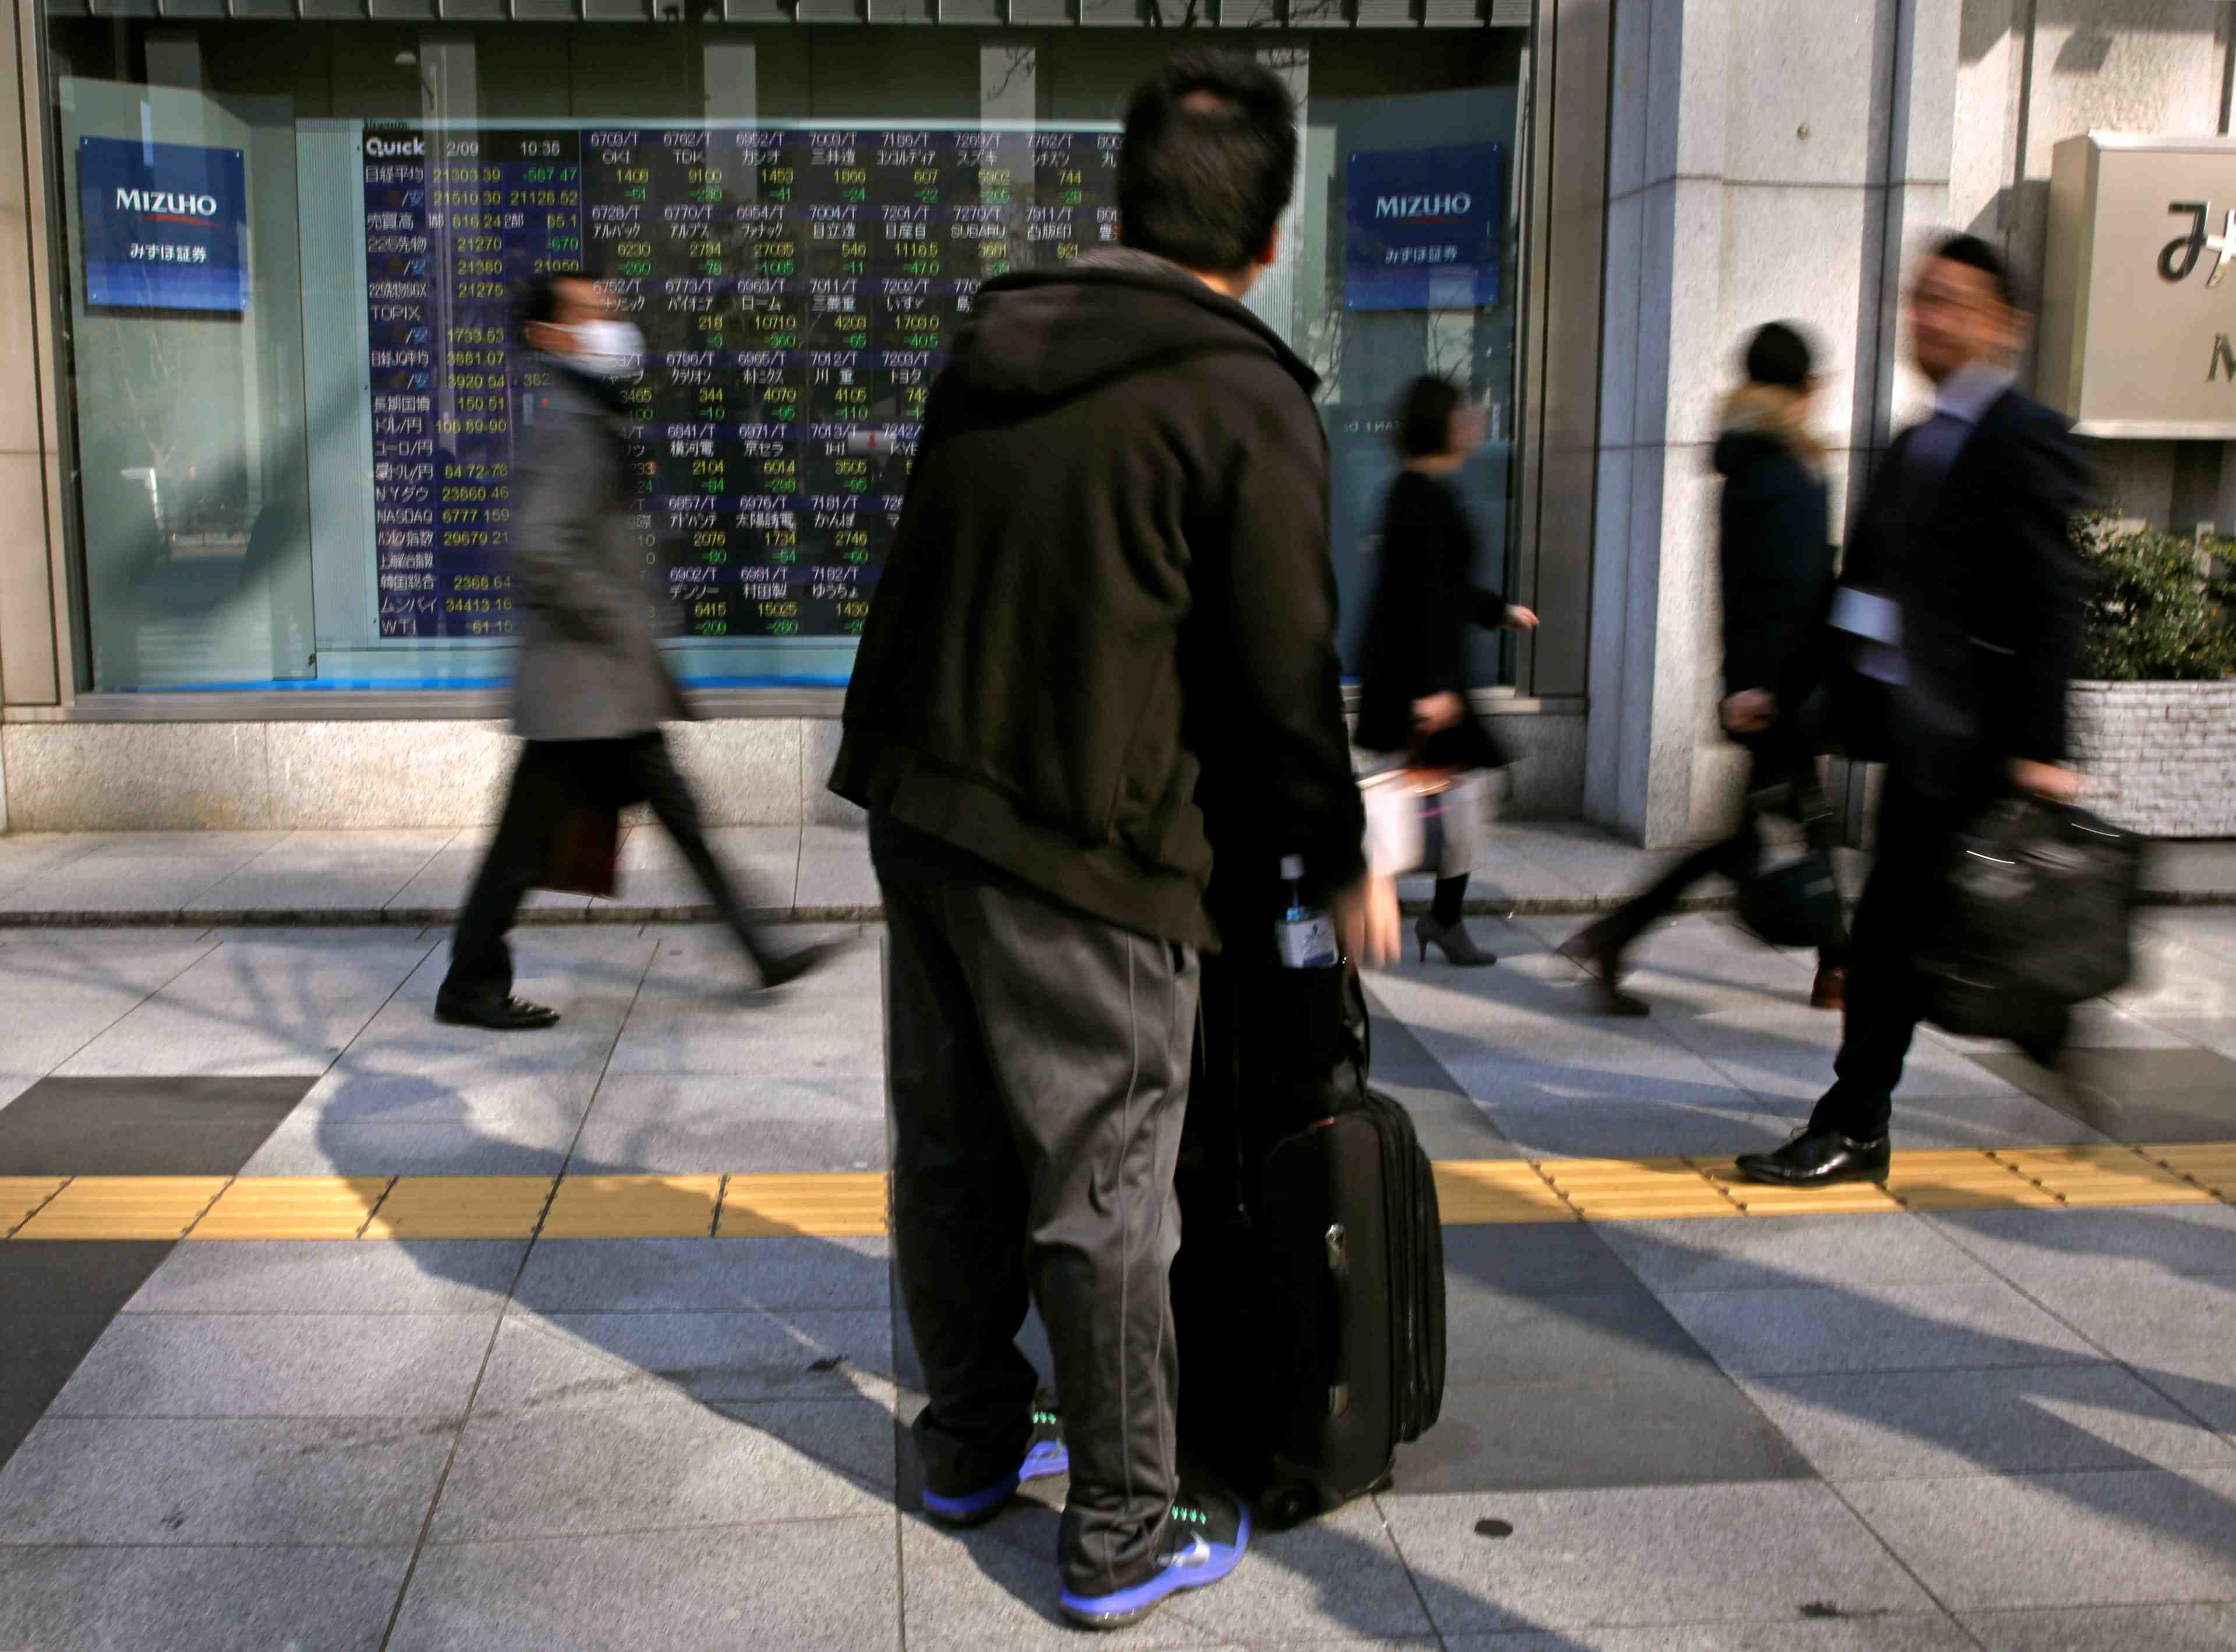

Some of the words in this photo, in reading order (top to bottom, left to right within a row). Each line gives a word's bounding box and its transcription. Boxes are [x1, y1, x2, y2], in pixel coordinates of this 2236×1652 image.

[366, 136, 426, 158] Quick
[603, 149, 629, 164] OKI
[673, 149, 705, 164] TDK
[742, 148, 781, 166] カシオ
[812, 148, 855, 165] 三井造
[877, 149, 936, 166] コンコルディア
[957, 149, 997, 166] スズキ
[1032, 151, 1070, 168] シチズン
[366, 165, 424, 183] 日経平均
[116, 187, 217, 215] MIZUHO
[1376, 192, 1471, 218] MIZUHO
[882, 204, 930, 220] 7201/T
[367, 211, 413, 231] 売買高
[593, 222, 641, 239] アルバック
[742, 221, 783, 239] ファナック
[814, 221, 856, 239] 日立造
[886, 222, 926, 239] 日産自
[951, 224, 1006, 239] SUBARU
[1027, 222, 1071, 240] 凸版印
[130, 242, 207, 263] みずほ証券
[1385, 245, 1457, 264] みずほ証券
[809, 278, 858, 293] 7011/T
[602, 295, 645, 312] ナソニック
[668, 295, 714, 312] パイオニア
[742, 295, 781, 312] ローム
[811, 295, 856, 312] 三菱重
[370, 305, 420, 321] TOPIX
[611, 355, 643, 366] 53/T
[810, 351, 858, 367] 7012/T
[672, 368, 712, 384] クラリオン
[891, 367, 922, 384] トヨタ
[376, 417, 422, 434] ドル/円
[670, 439, 714, 457] 横河電
[744, 440, 783, 457] 京セラ
[825, 441, 845, 455] IHI
[377, 508, 433, 524] NASDAQ
[671, 512, 717, 529] アドバンテ
[736, 511, 797, 529] 太陽誘電
[670, 583, 720, 600] デンソー
[744, 582, 787, 600] 村田製
[812, 582, 858, 600] ゆうちょ
[381, 597, 437, 613] ムンバイ
[382, 620, 416, 634] WTI
